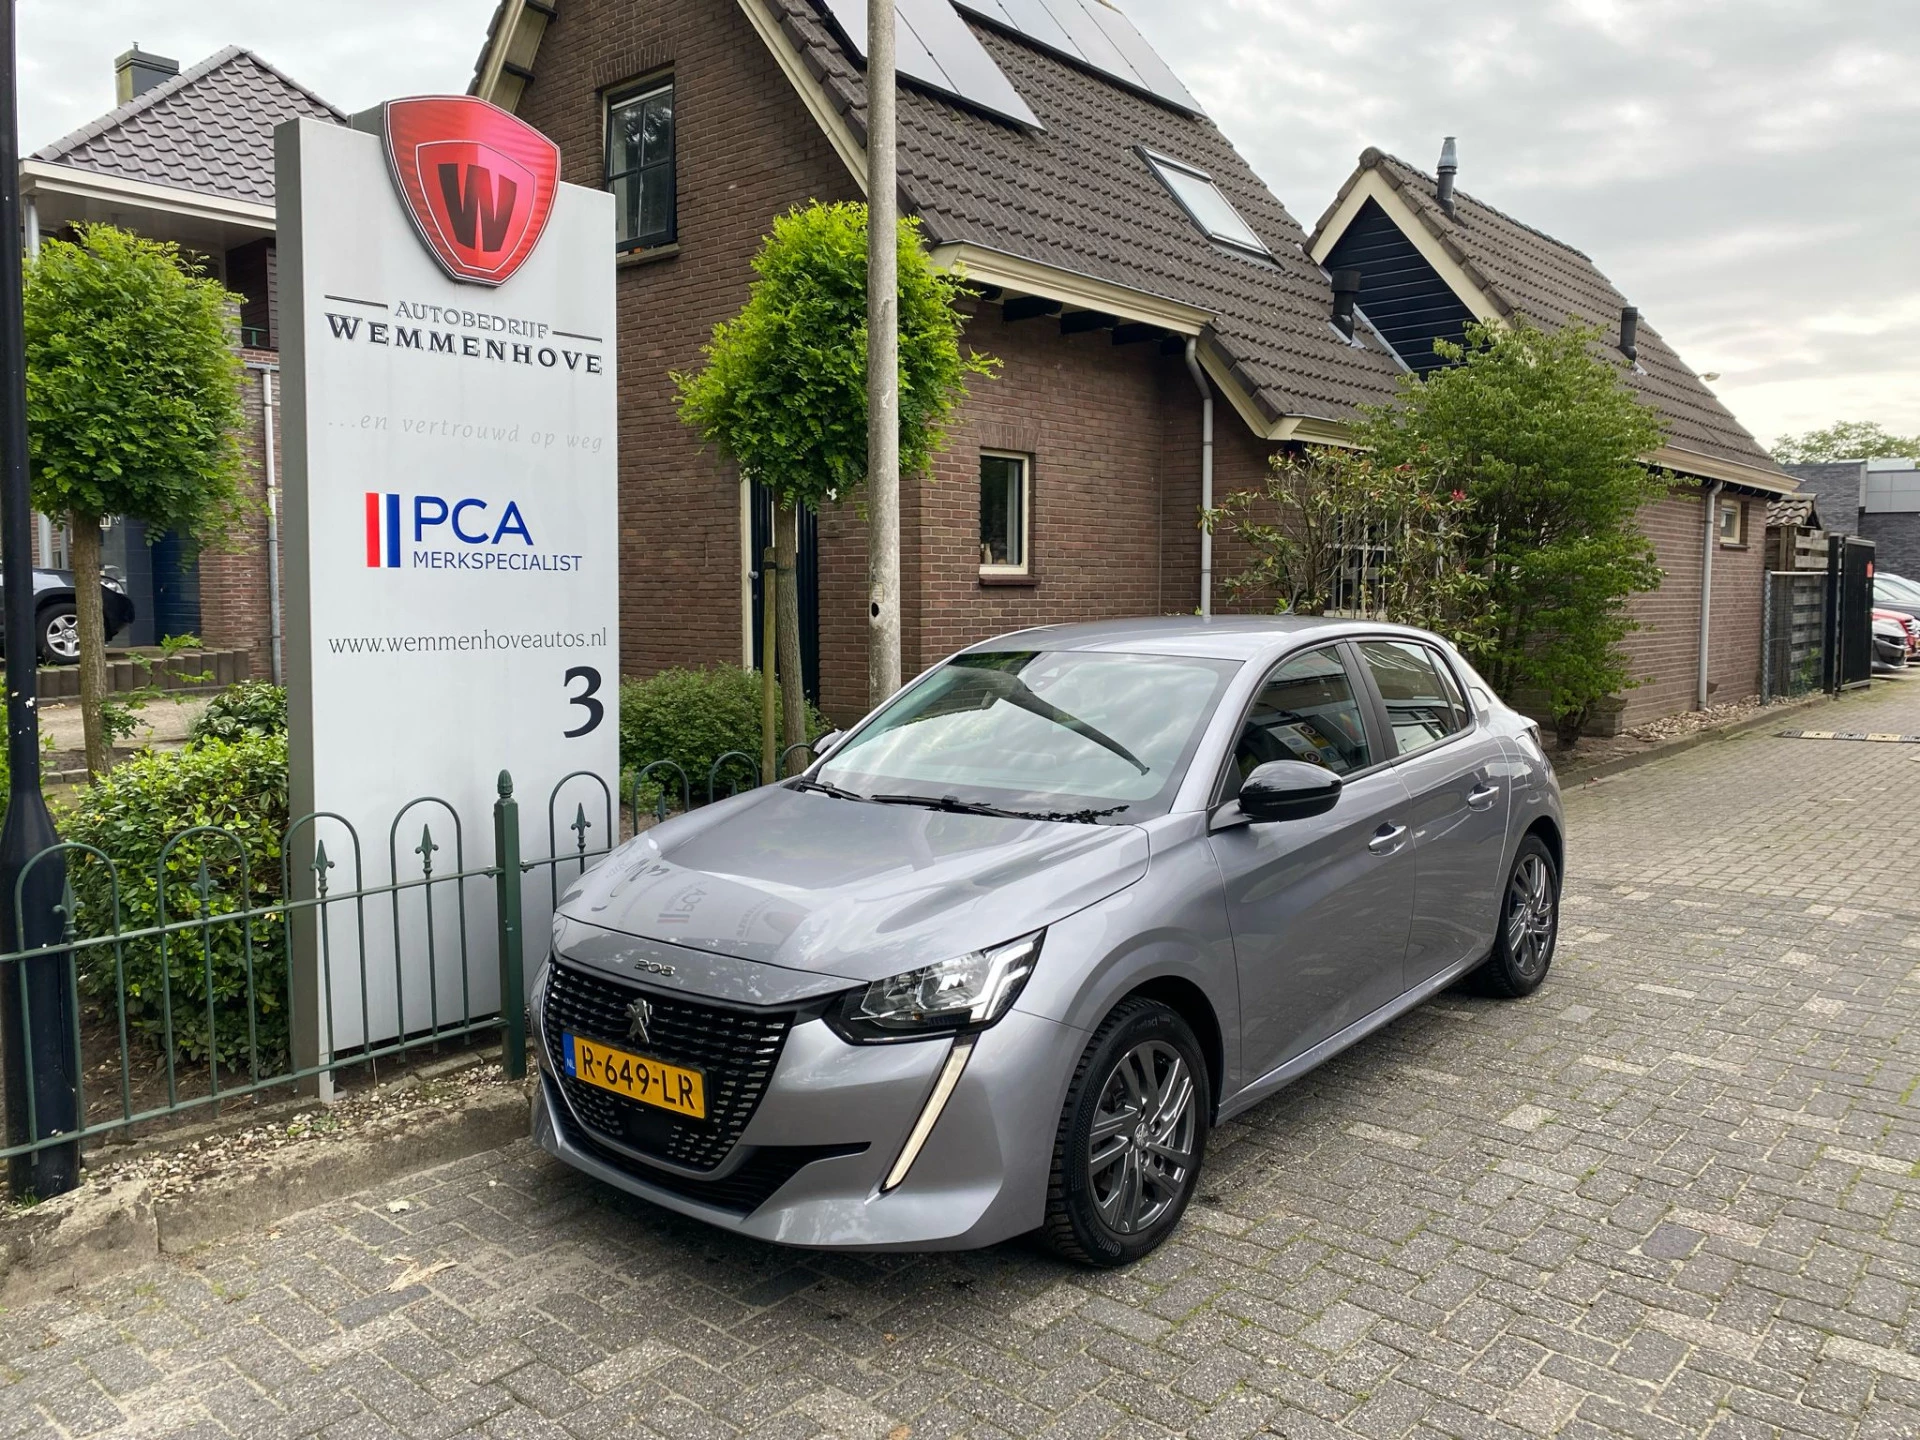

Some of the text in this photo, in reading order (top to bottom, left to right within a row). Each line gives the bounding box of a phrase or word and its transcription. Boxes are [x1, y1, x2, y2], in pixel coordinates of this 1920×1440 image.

[437, 163, 517, 253] W
[395, 300, 549, 339] AUTOBEDRIJF
[324, 312, 603, 375] WEMMENHOVE
[402, 417, 520, 443] vertrouwd
[531, 430, 556, 449] op
[566, 435, 603, 454] weg
[413, 495, 534, 546] PCA
[413, 550, 583, 572] MERKSPECIALIST
[328, 626, 608, 655] www.wemmenhoveautos.nl
[563, 665, 605, 738] 3
[634, 958, 676, 977] 208
[566, 1058, 576, 1069] NL
[581, 1045, 696, 1110] R-649-LR
